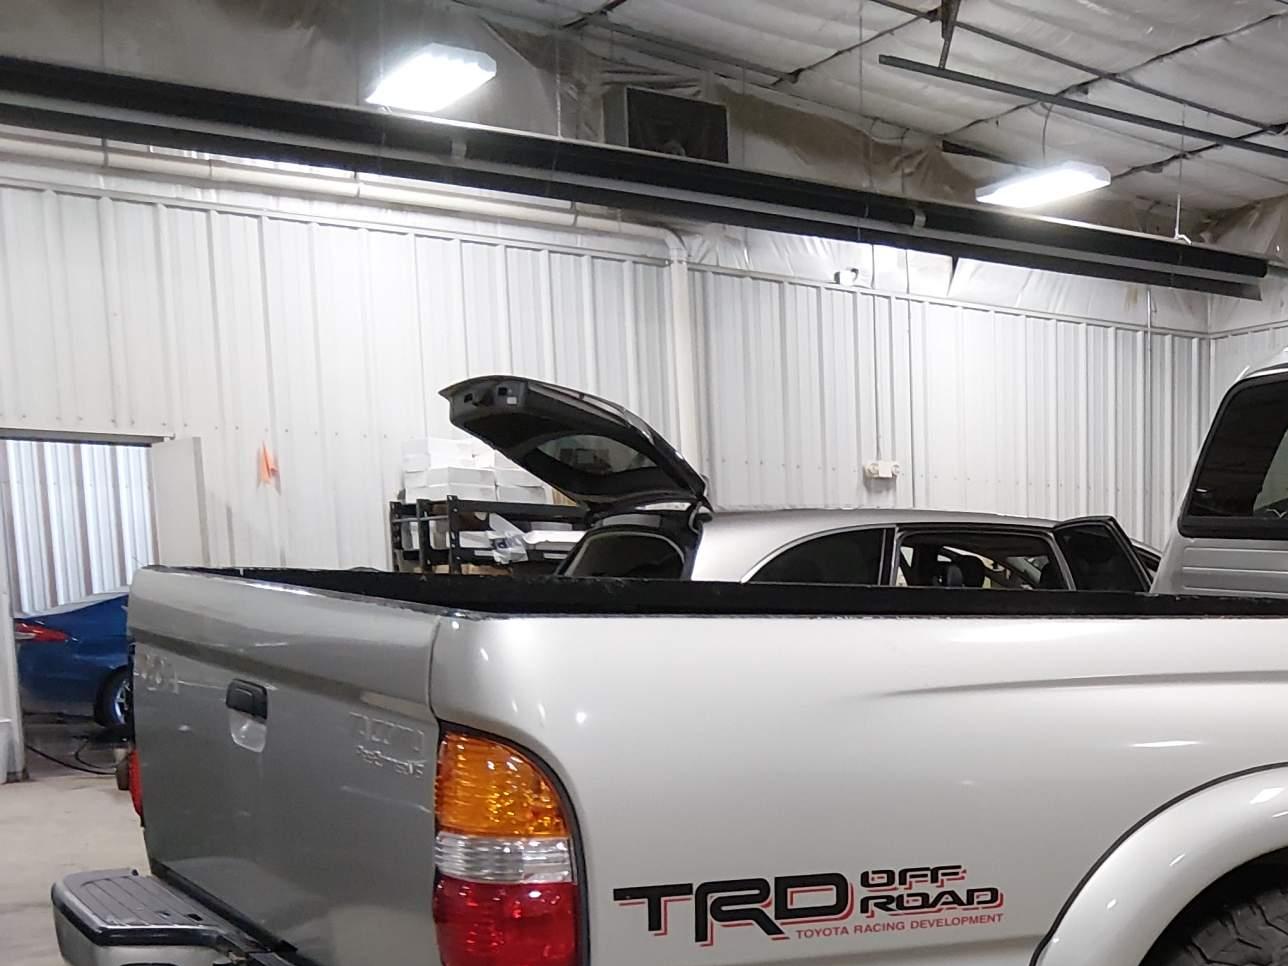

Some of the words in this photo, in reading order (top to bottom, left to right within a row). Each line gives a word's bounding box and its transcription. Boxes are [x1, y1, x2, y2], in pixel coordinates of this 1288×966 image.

[860, 865, 967, 892] OFF
[612, 872, 855, 947] TRD
[860, 887, 1004, 918] ROAD
[797, 926, 849, 939] TOYOTA
[853, 921, 905, 934] RACING
[910, 913, 1005, 930] DEVELOPMENT
